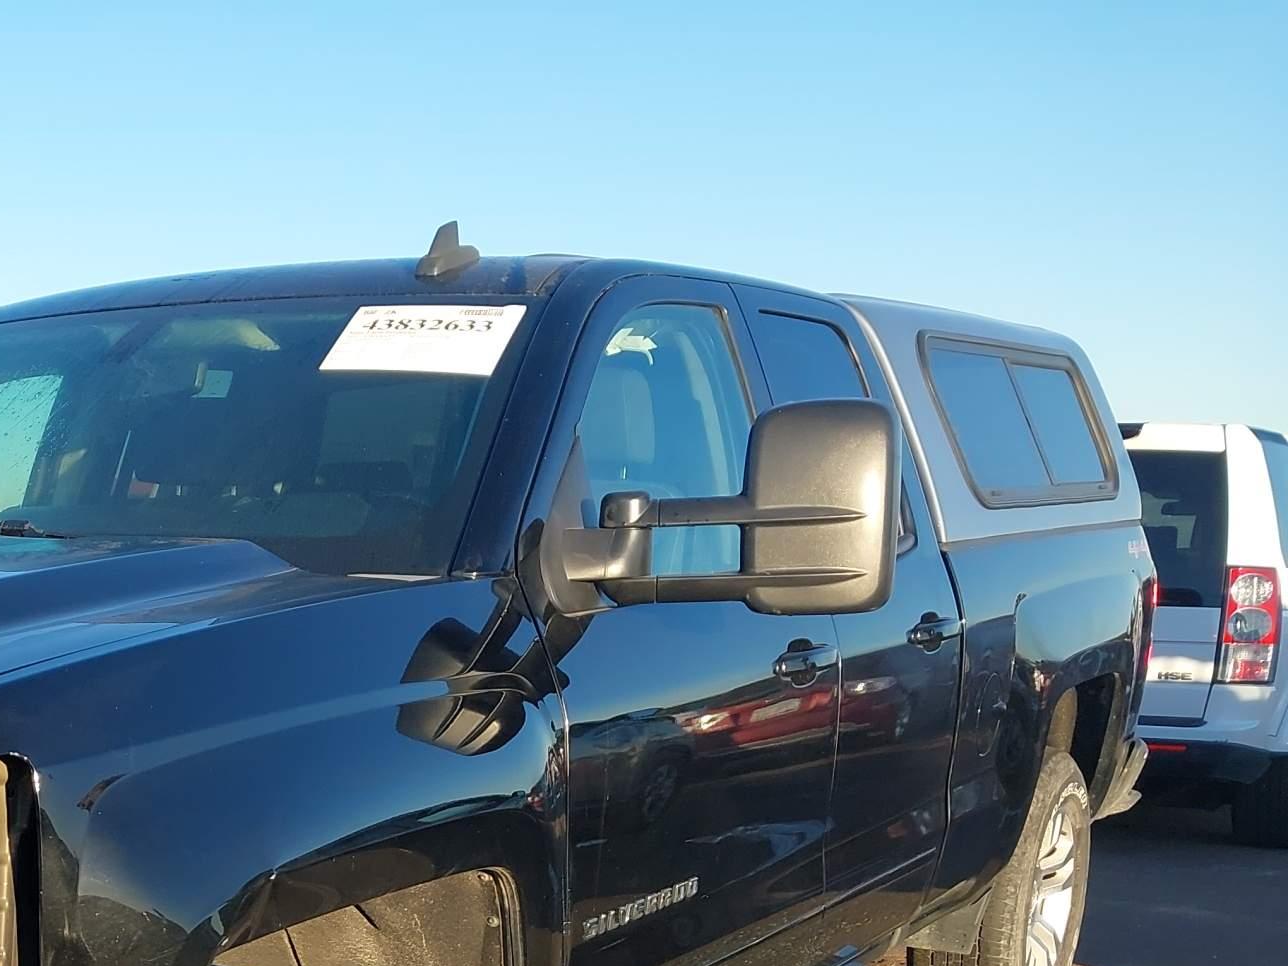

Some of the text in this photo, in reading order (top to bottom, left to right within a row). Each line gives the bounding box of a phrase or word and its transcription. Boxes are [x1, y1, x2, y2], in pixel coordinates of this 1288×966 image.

[362, 318, 493, 332] 43832633
[1157, 671, 1193, 681] HSE
[582, 876, 700, 941] SILVERADO
